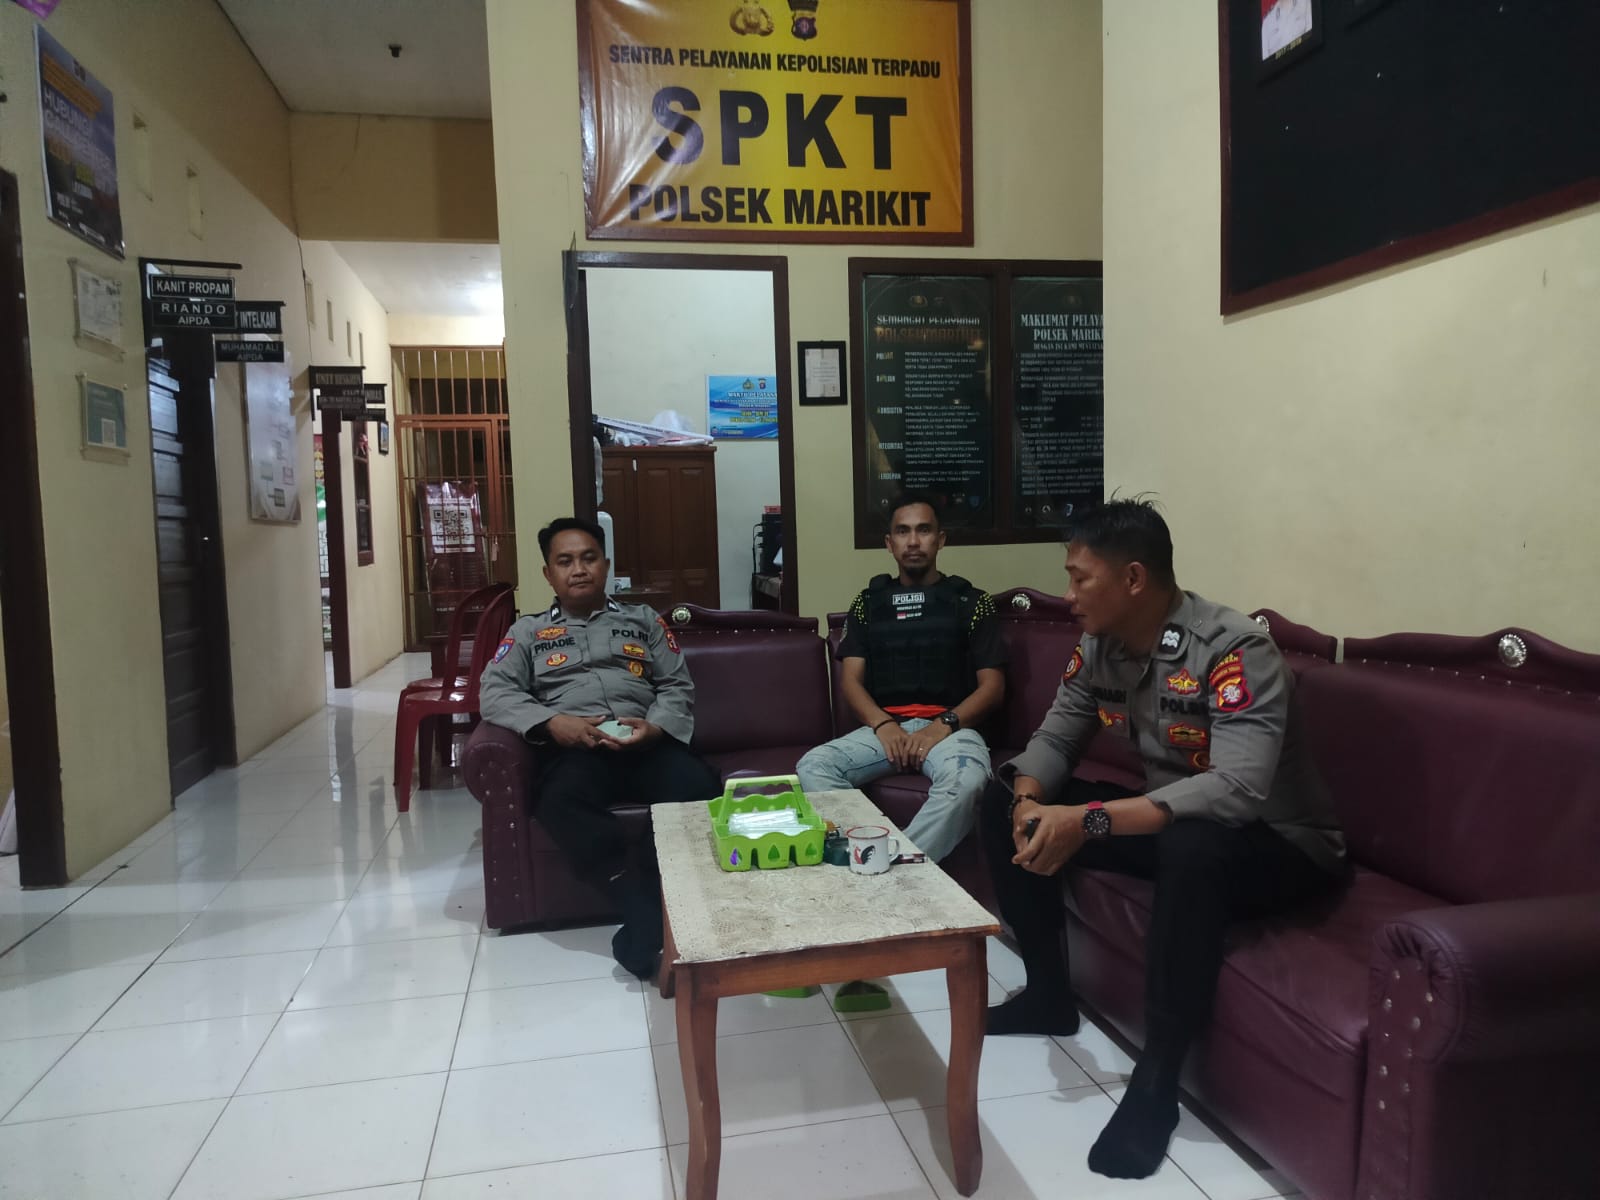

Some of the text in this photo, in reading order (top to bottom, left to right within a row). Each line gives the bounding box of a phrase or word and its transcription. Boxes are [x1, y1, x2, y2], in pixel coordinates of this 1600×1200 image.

[609, 45, 941, 79] SENTRA PELAYANAN KEPOLISIAN TERPADU
[651, 86, 908, 170] SPKT
[629, 184, 931, 227] POLSEK MARIKIT
[156, 280, 230, 295] KANIT PROPAM
[162, 303, 226, 315] RIANDO
[178, 316, 211, 325] AIPDA
[240, 311, 277, 329] INTELKAM
[1021, 314, 1069, 327] MAKLUMAT
[1033, 328, 1069, 341] POLSEK
[612, 629, 648, 643] POLRI
[534, 636, 576, 655] PRIADIE
